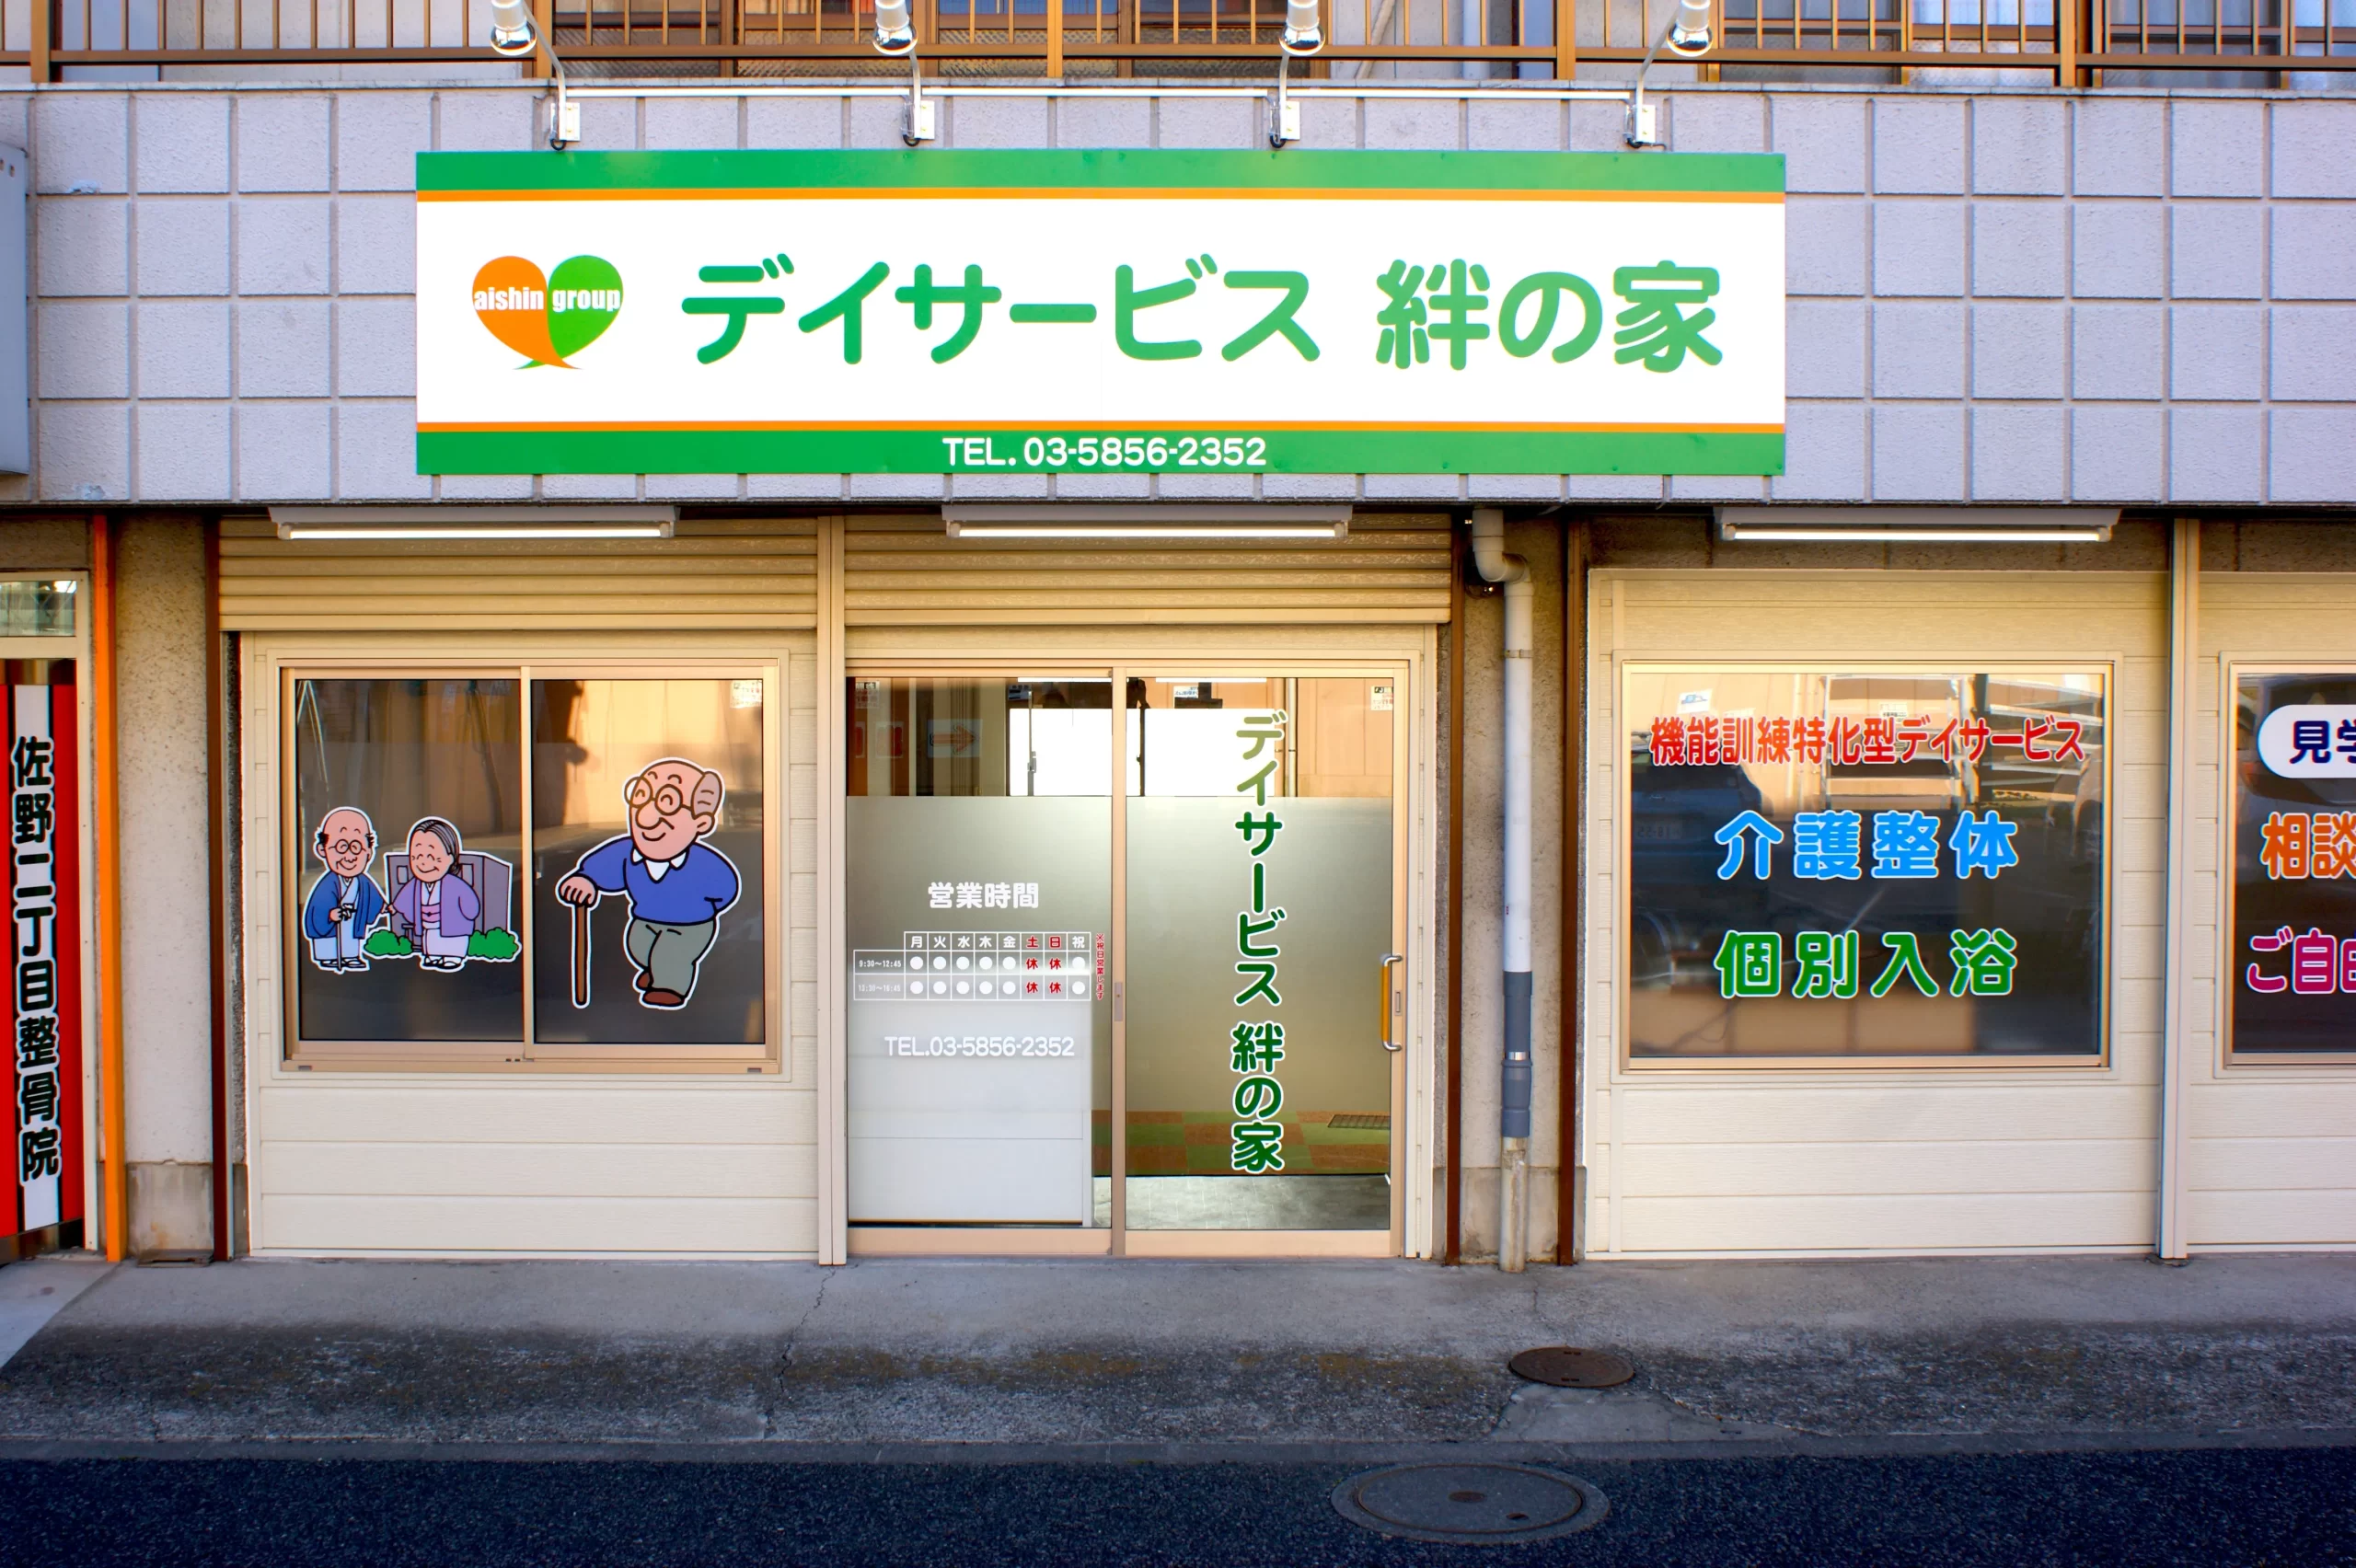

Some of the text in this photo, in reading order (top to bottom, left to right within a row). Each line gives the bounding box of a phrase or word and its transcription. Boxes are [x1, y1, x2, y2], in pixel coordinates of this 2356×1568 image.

[474, 287, 621, 312] aishin group
[681, 253, 1723, 374] デイサービス 絆の家
[941, 437, 1266, 467] TEL. 03-5856-2352
[1649, 714, 2086, 767] 機能訓練特化型デイサービス
[1715, 809, 2019, 880] 介護整体
[2259, 811, 2356, 880] 相談
[928, 882, 1039, 909] 営業時間
[11, 736, 61, 1184] 佐野二丁目整骨院
[910, 935, 1085, 949] 月 火 水 木 金 土 日 祝
[1230, 709, 1288, 1176] デイサービス 絆の家
[1025, 957, 1061, 970] 休 休
[1715, 928, 2018, 998] 個別入浴
[1025, 981, 1061, 994] 休 休
[884, 1036, 1075, 1056] TEL.03-5856-2352
